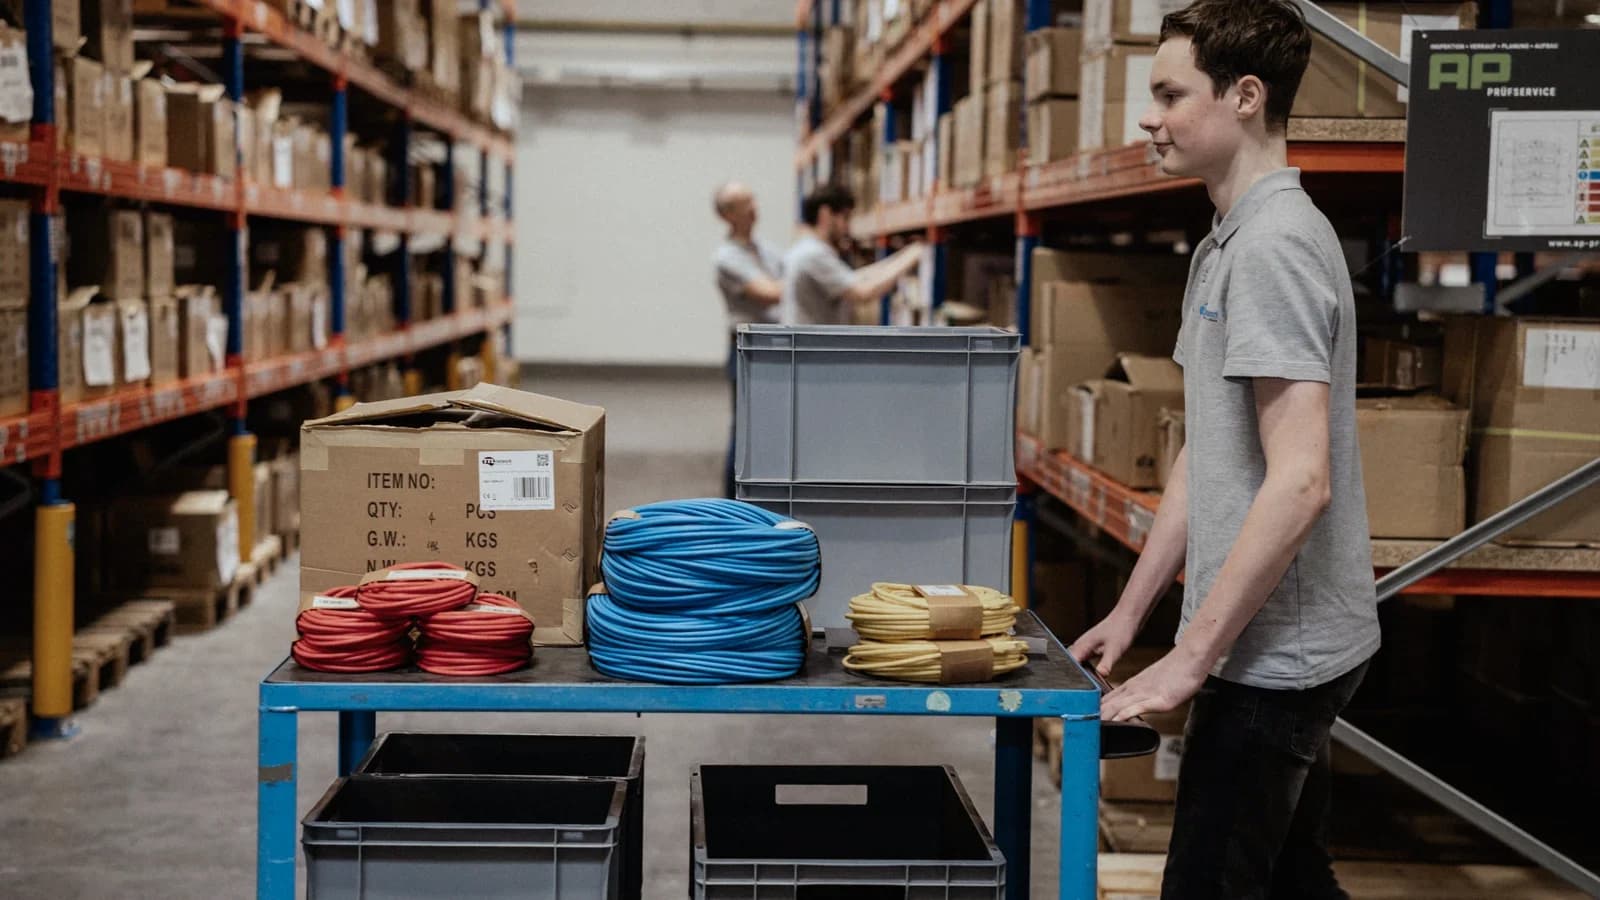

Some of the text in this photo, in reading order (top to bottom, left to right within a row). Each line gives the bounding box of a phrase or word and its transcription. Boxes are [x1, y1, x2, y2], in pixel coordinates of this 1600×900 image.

[1429, 53, 1512, 90] AP
[1486, 86, 1556, 97] PRÜFSERVICE
[367, 472, 435, 490] ITEM NO:
[367, 501, 496, 519] QTY: PCS
[367, 530, 406, 547] G.W.:
[466, 531, 498, 548] KGS
[464, 560, 496, 577] KGS
